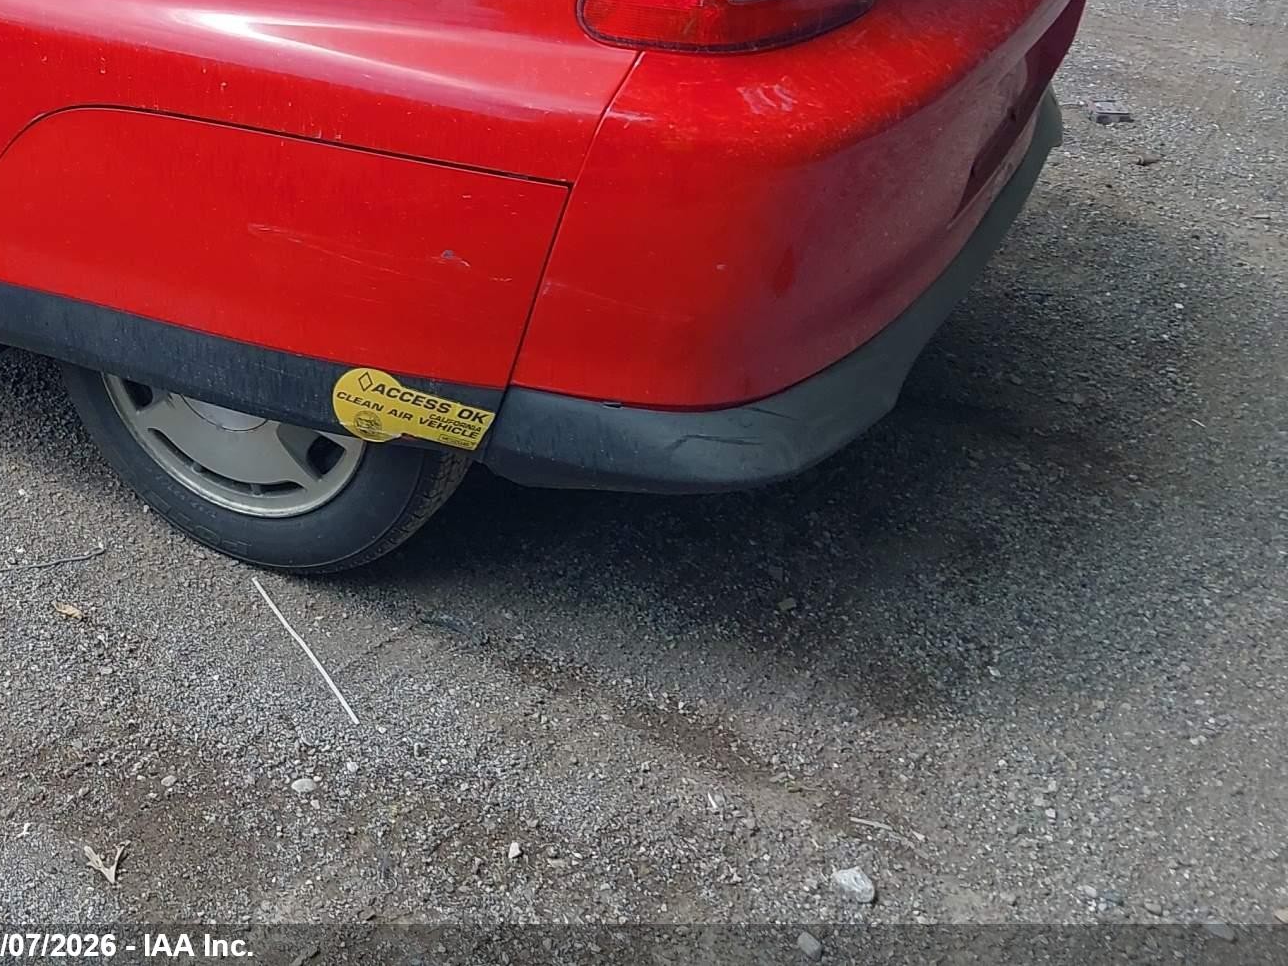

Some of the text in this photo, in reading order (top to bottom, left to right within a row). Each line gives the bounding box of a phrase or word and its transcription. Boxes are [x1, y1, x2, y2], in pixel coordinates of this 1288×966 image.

[336, 391, 480, 440] CLEAN AIR VEHICLE
[371, 383, 489, 424] ACCESS OK
[428, 414, 482, 432] CALIFORNIA
